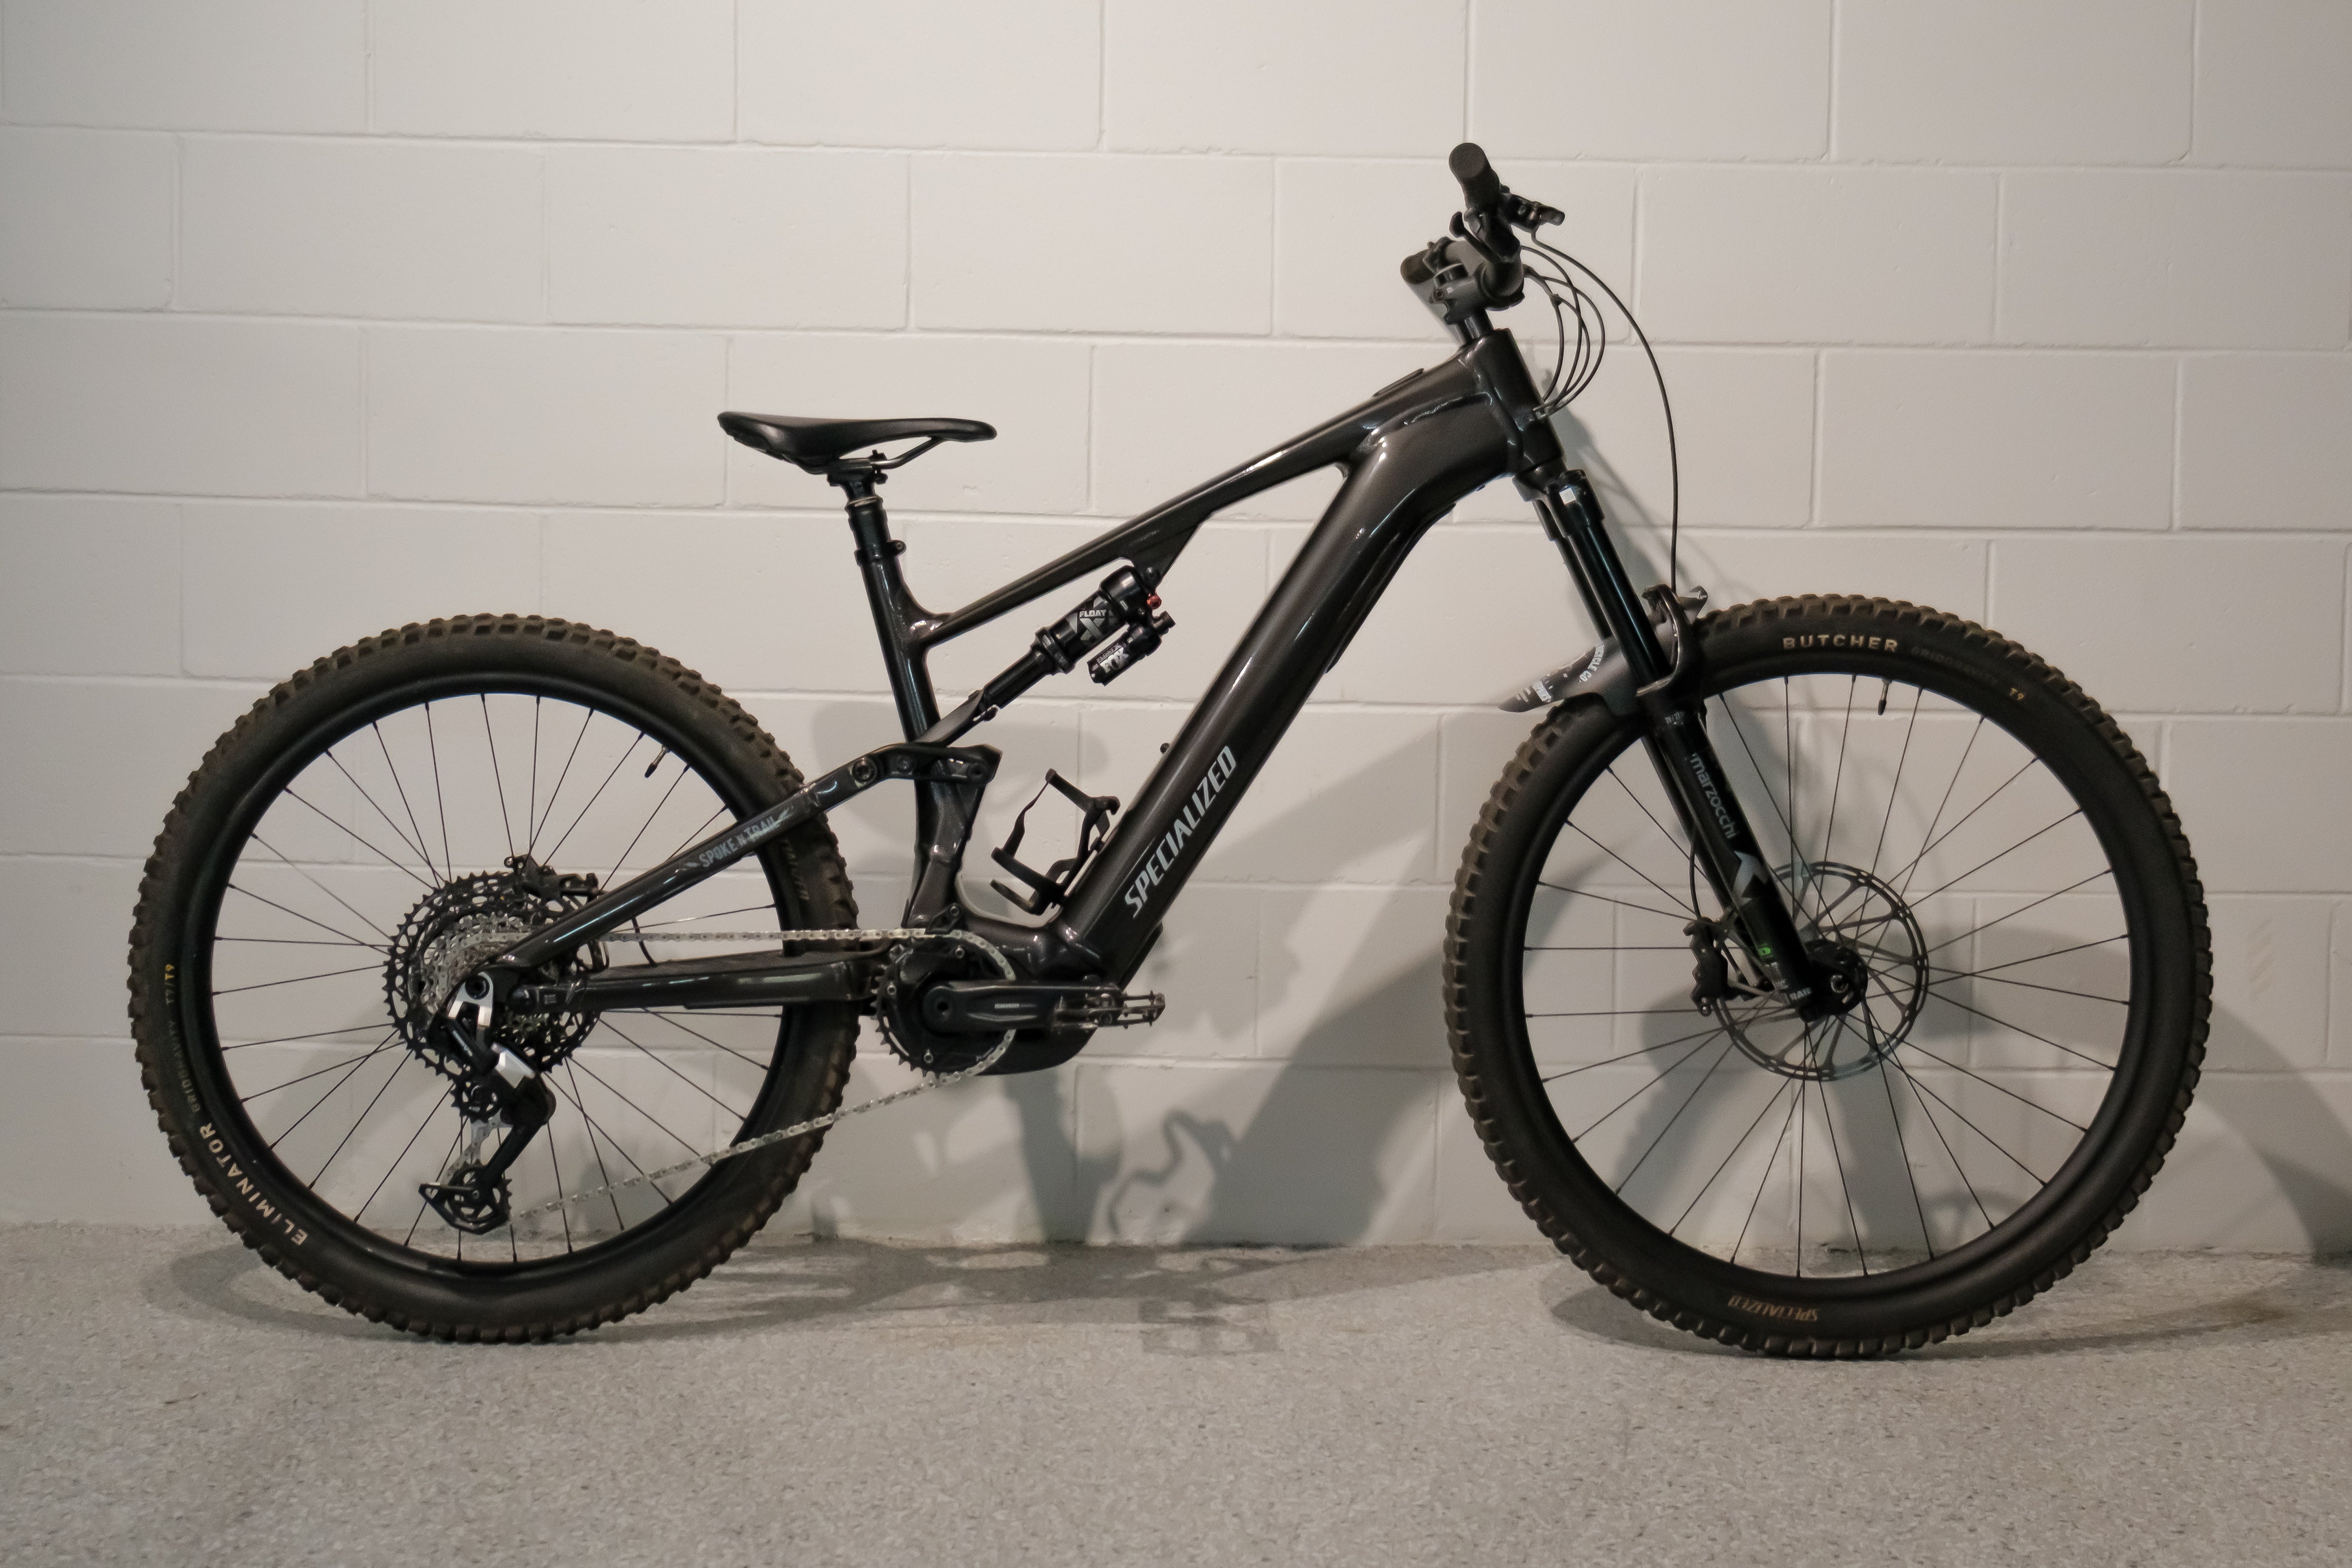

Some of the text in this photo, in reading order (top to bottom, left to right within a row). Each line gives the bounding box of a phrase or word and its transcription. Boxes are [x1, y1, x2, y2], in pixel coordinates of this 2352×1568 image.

[1079, 609, 1106, 618] FLOAT
[1100, 647, 1129, 673] FOX
[1783, 634, 1898, 652] BUTCHER
[2008, 687, 2025, 702] T9
[1690, 752, 1736, 838] marzocchi
[699, 838, 736, 868] SPOKE
[742, 816, 780, 845] TRAIL
[1124, 745, 1236, 918] SPECIALIZED
[199, 1123, 308, 1245] ELIMINATOR
[1728, 1294, 1820, 1321] SPECIALIZED
